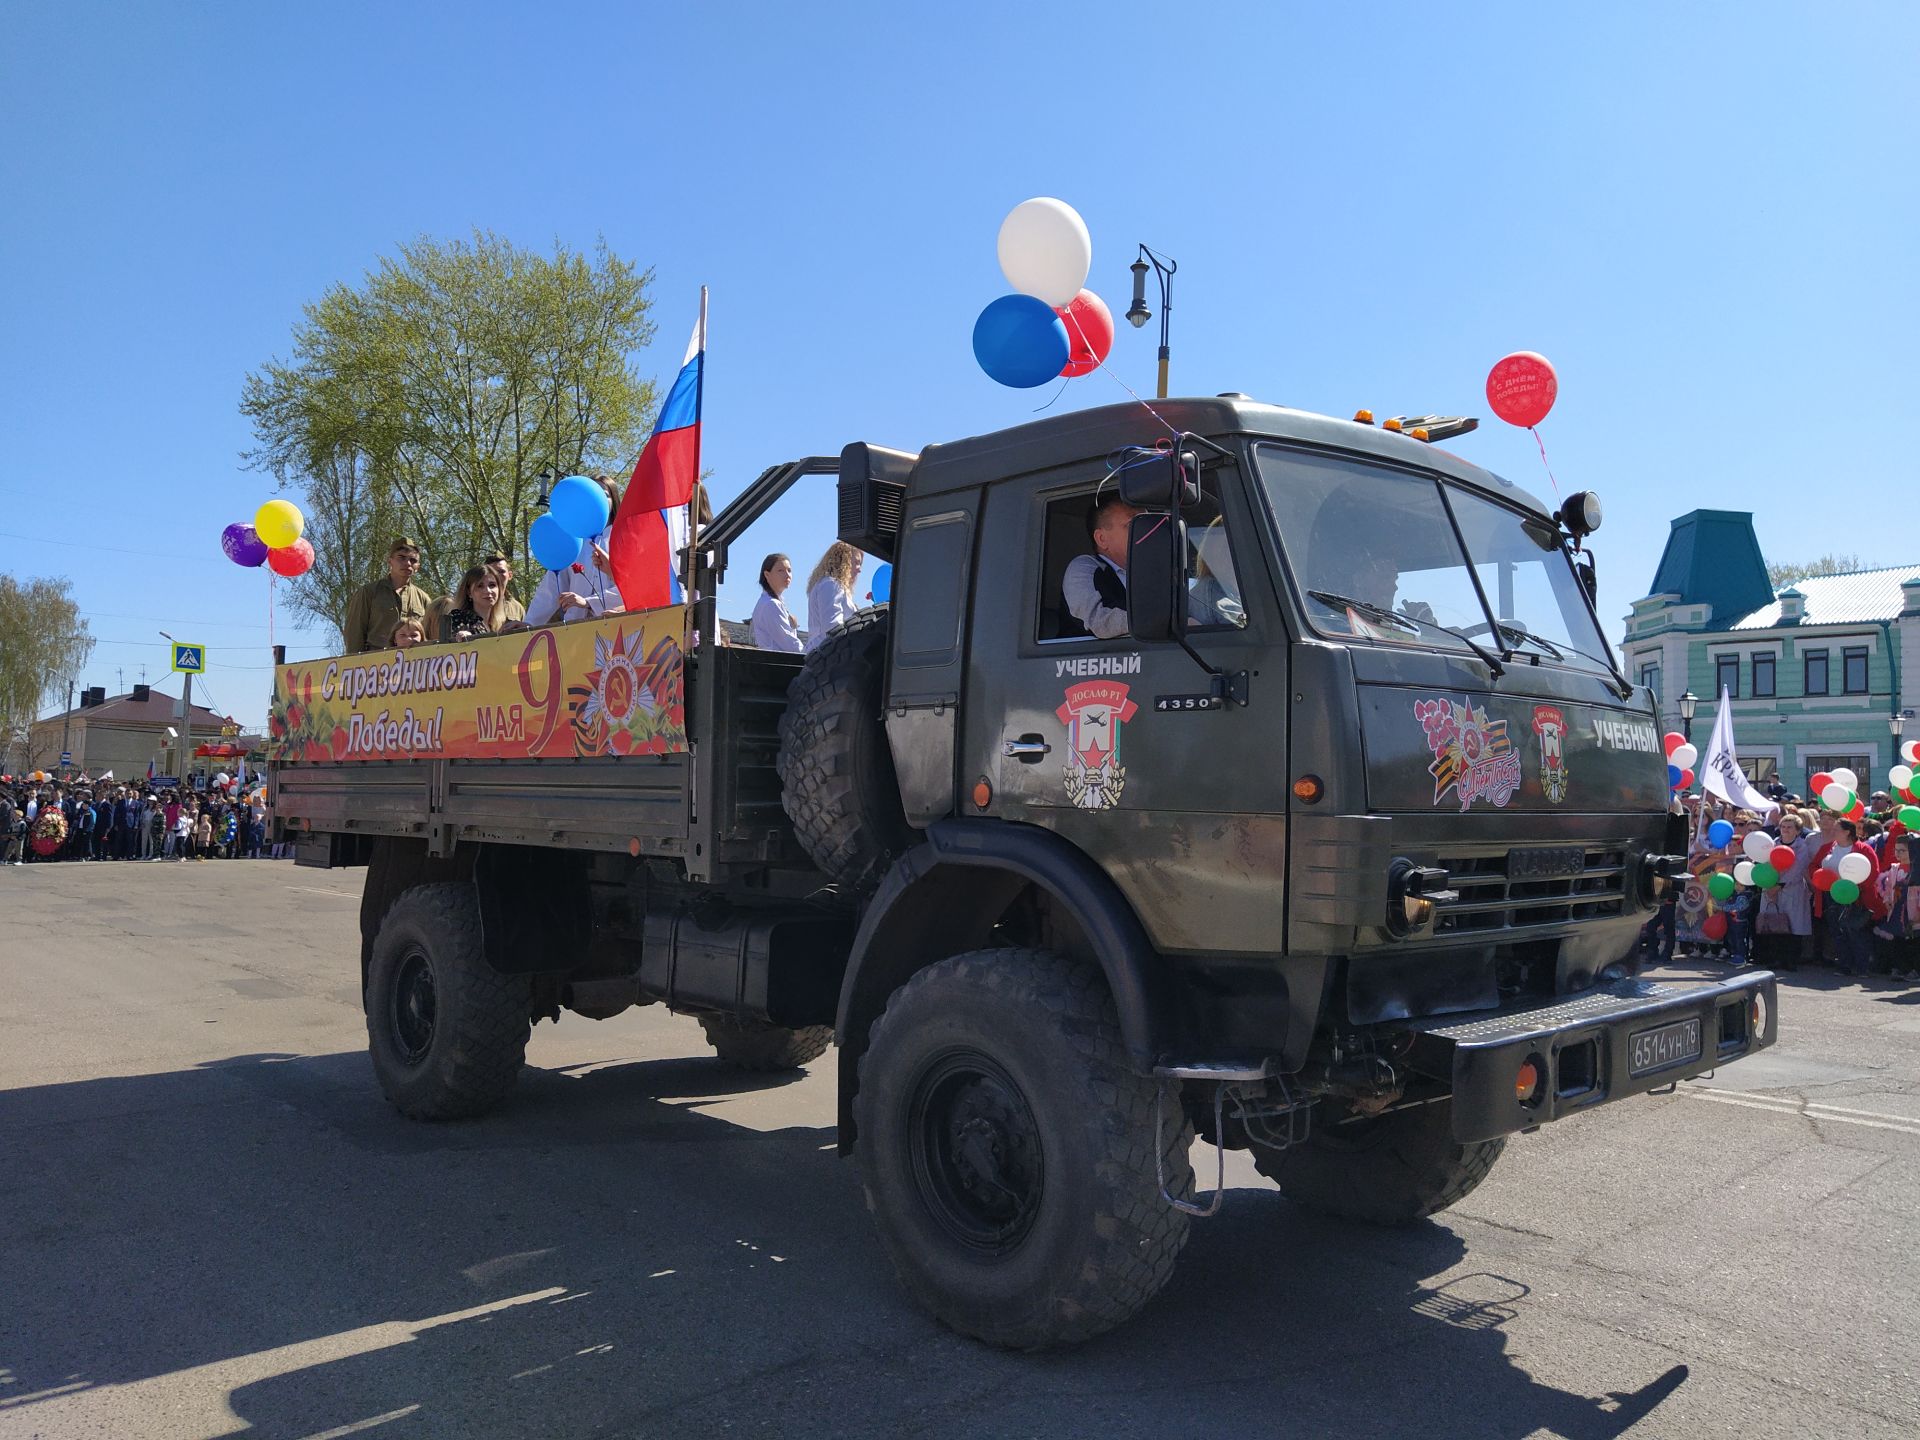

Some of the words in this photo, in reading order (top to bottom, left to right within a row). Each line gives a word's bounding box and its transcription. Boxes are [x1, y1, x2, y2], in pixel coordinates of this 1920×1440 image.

[321, 661, 338, 702] С
[339, 650, 479, 709] праздником
[1056, 653, 1141, 677] УЧЕБНЫЙ
[517, 629, 562, 757] 9
[1072, 688, 1108, 705] ДОСААФ
[1110, 690, 1122, 701] РТ
[1158, 698, 1210, 710] 4350
[347, 705, 444, 753] Победы!
[477, 703, 526, 743] МАЯ
[1593, 720, 1660, 753] УЧЕБНЫЙ
[1685, 1023, 1696, 1046] 76
